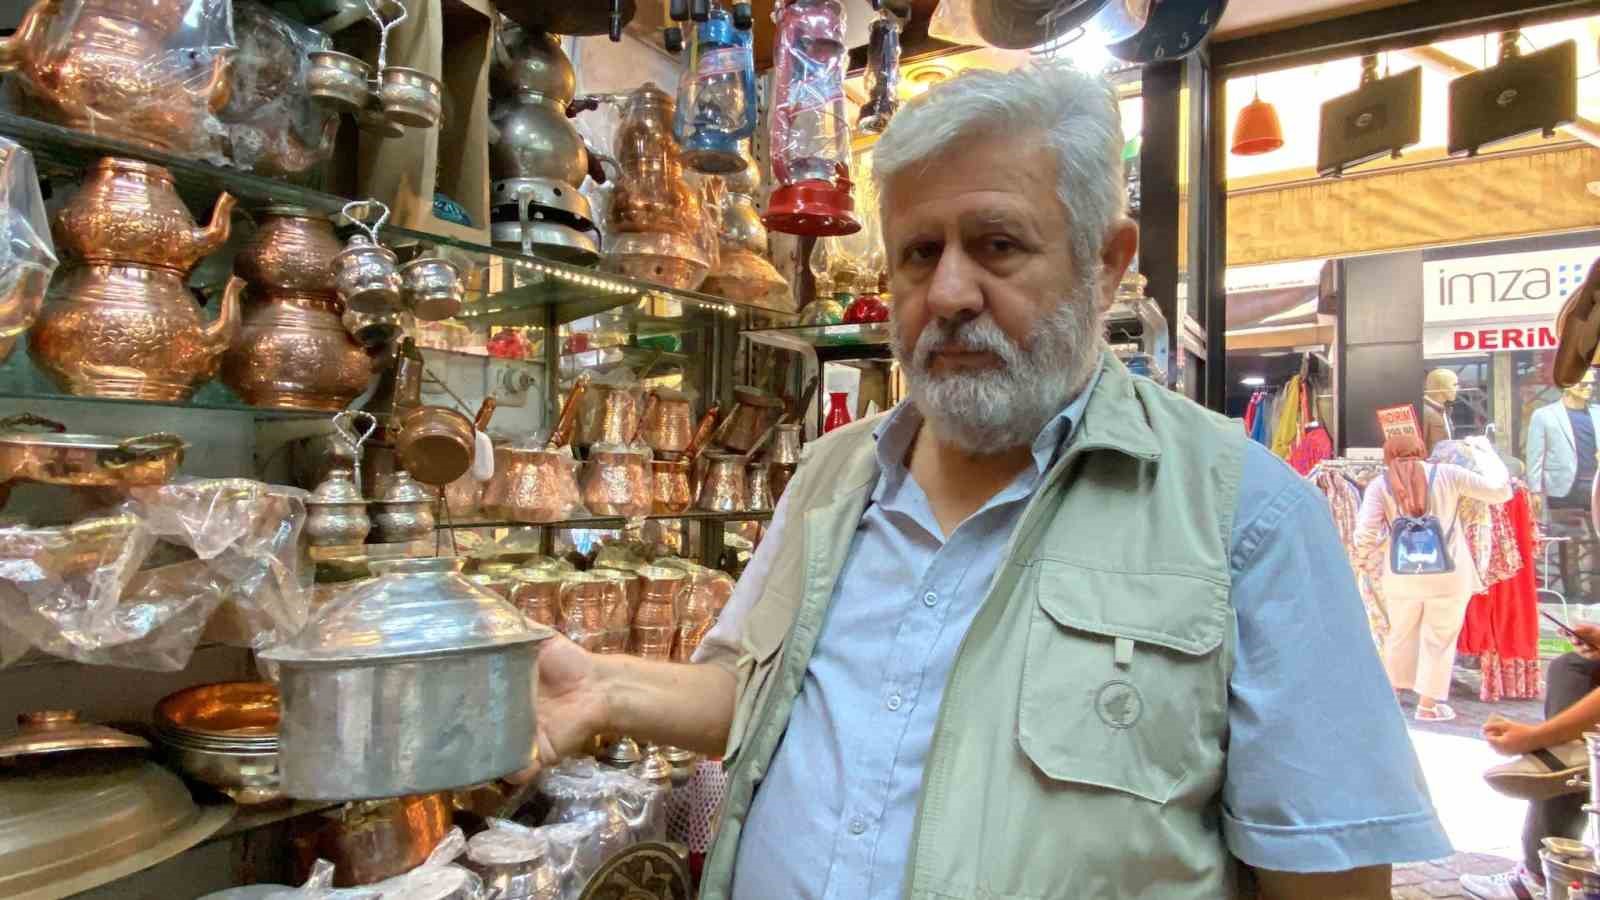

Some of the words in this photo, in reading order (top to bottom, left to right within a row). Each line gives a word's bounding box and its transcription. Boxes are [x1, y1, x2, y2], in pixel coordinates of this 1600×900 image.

[1199, 7, 1209, 25] 4
[1179, 31, 1189, 49] 5
[1154, 43, 1165, 58] 6
[1440, 267, 1551, 306] imza
